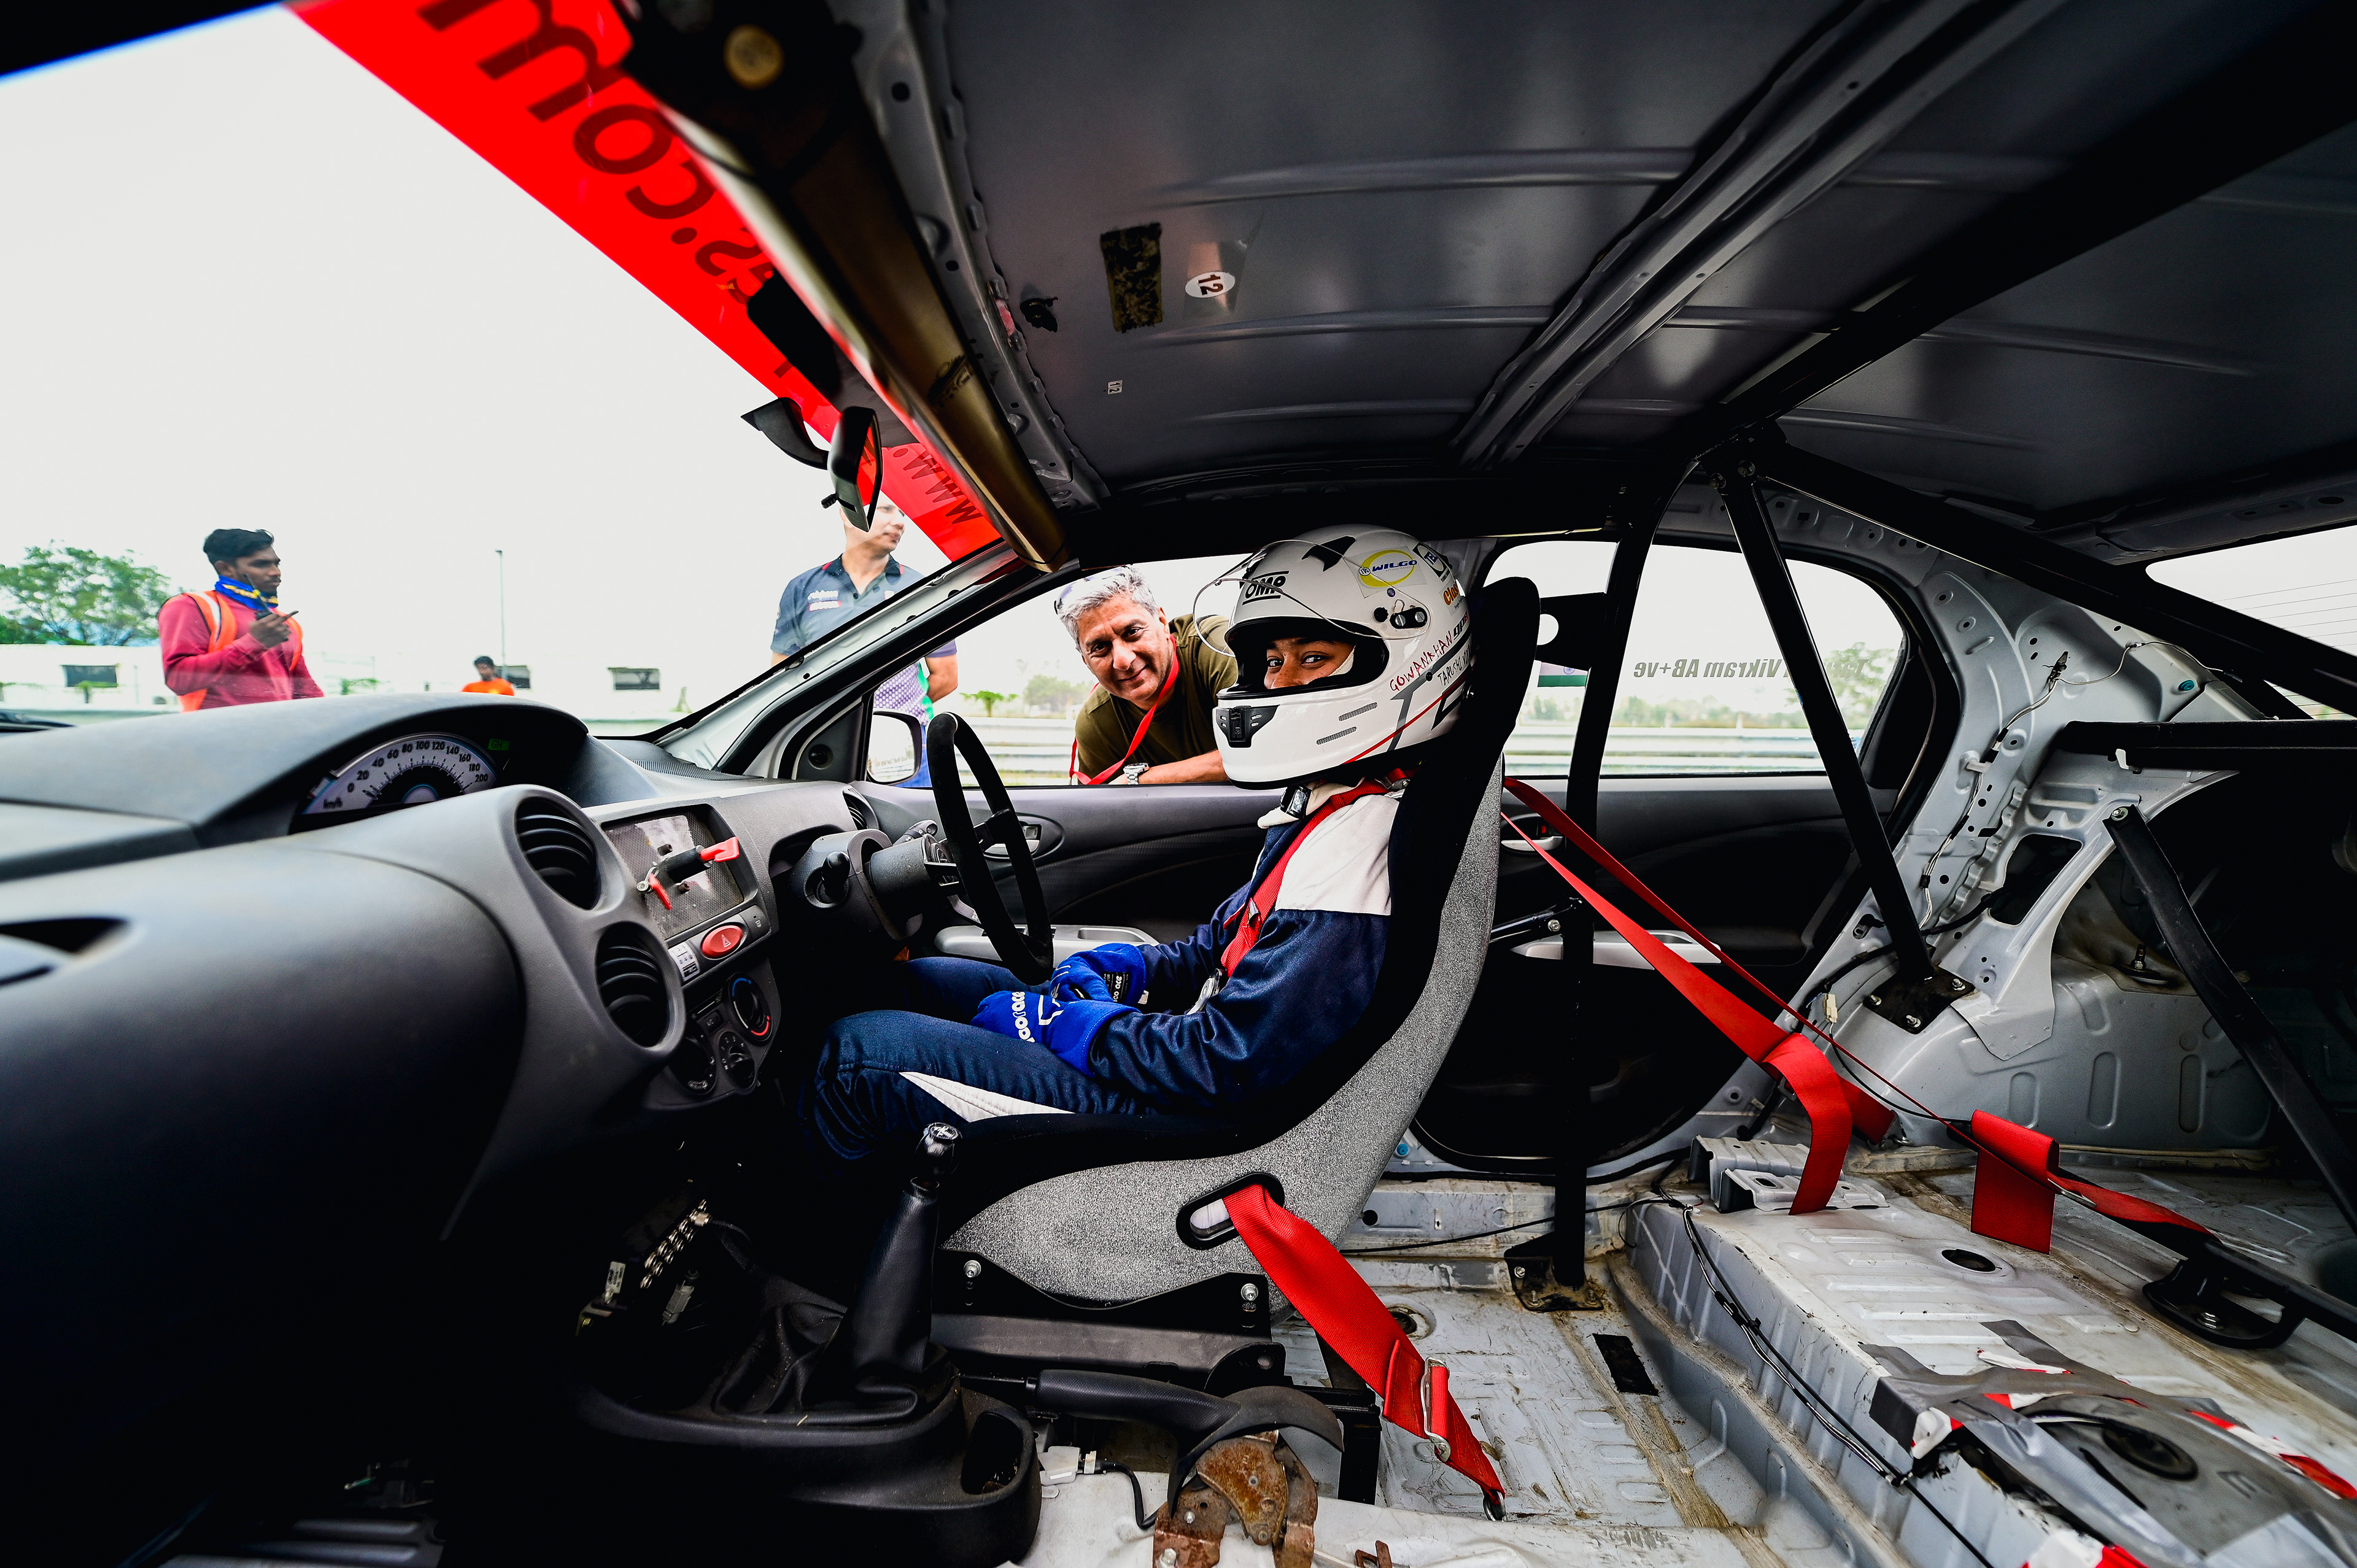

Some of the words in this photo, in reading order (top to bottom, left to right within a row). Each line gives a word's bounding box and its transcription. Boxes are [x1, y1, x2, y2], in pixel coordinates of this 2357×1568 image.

[1198, 274, 1223, 295] 12
[1109, 382, 1121, 393] 12
[1372, 560, 1418, 572] WILGO
[1245, 576, 1287, 598] OMP
[347, 782, 355, 793] 0
[357, 770, 370, 780] 20
[371, 757, 384, 767] 40
[387, 749, 399, 759] 60
[401, 743, 413, 753] 80
[416, 741, 430, 750] 100
[432, 741, 446, 750] 120
[446, 745, 459, 755] 140
[459, 754, 471, 762] 160
[475, 773, 489, 782] 200
[323, 797, 343, 809] km/h
